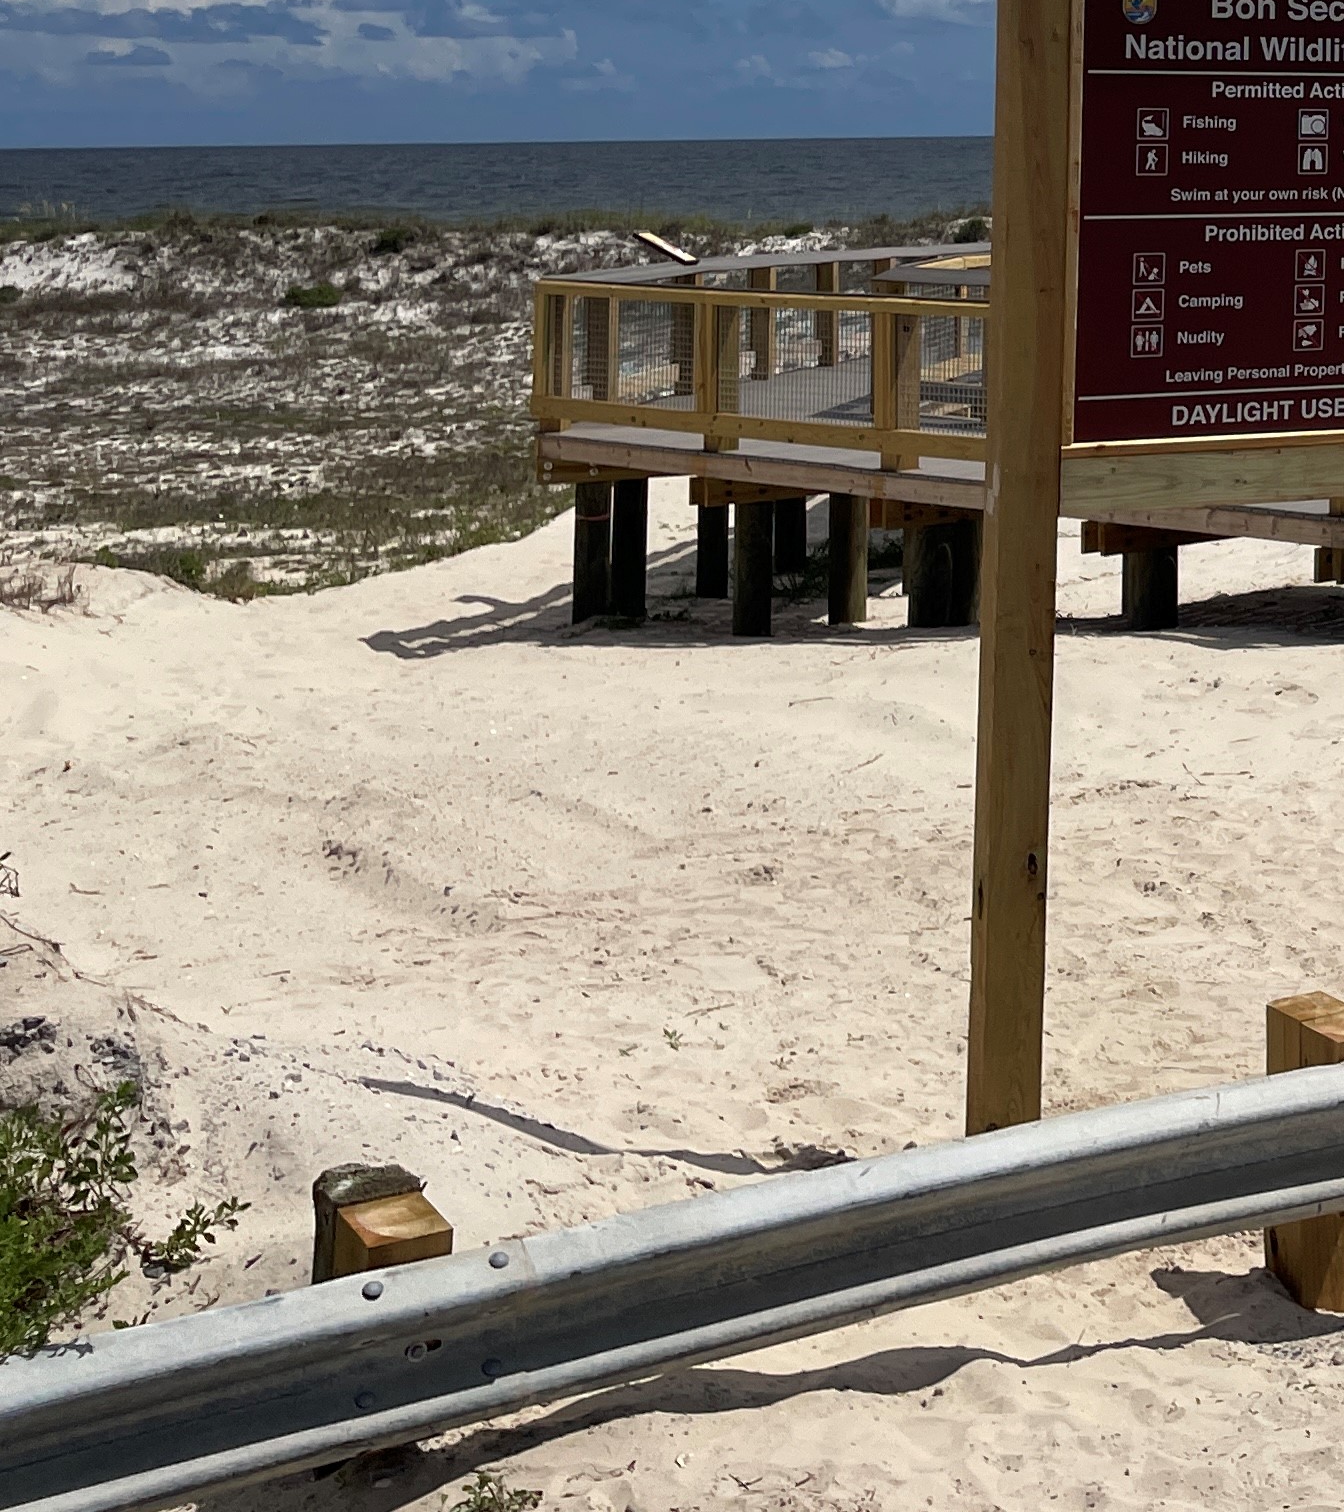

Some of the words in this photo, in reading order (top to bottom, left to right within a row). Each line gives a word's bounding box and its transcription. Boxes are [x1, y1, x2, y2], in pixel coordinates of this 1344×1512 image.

[1126, 34, 1249, 60] National
[1212, 81, 1304, 98] Permitted
[1183, 116, 1236, 131] Fishing
[1182, 151, 1228, 166] Hiking
[1171, 188, 1210, 201] Swim
[1215, 189, 1228, 200] at
[1233, 191, 1265, 203] your
[1269, 190, 1298, 200] own
[1303, 187, 1328, 199] risk
[1205, 224, 1304, 241] Prohibited
[1180, 261, 1211, 273] Pets
[1179, 294, 1243, 309] Camping
[1178, 331, 1224, 346] Nudity
[1166, 369, 1223, 383] Leaving
[1228, 365, 1290, 379] Personal
[1172, 400, 1294, 425] DAYLIGHT
